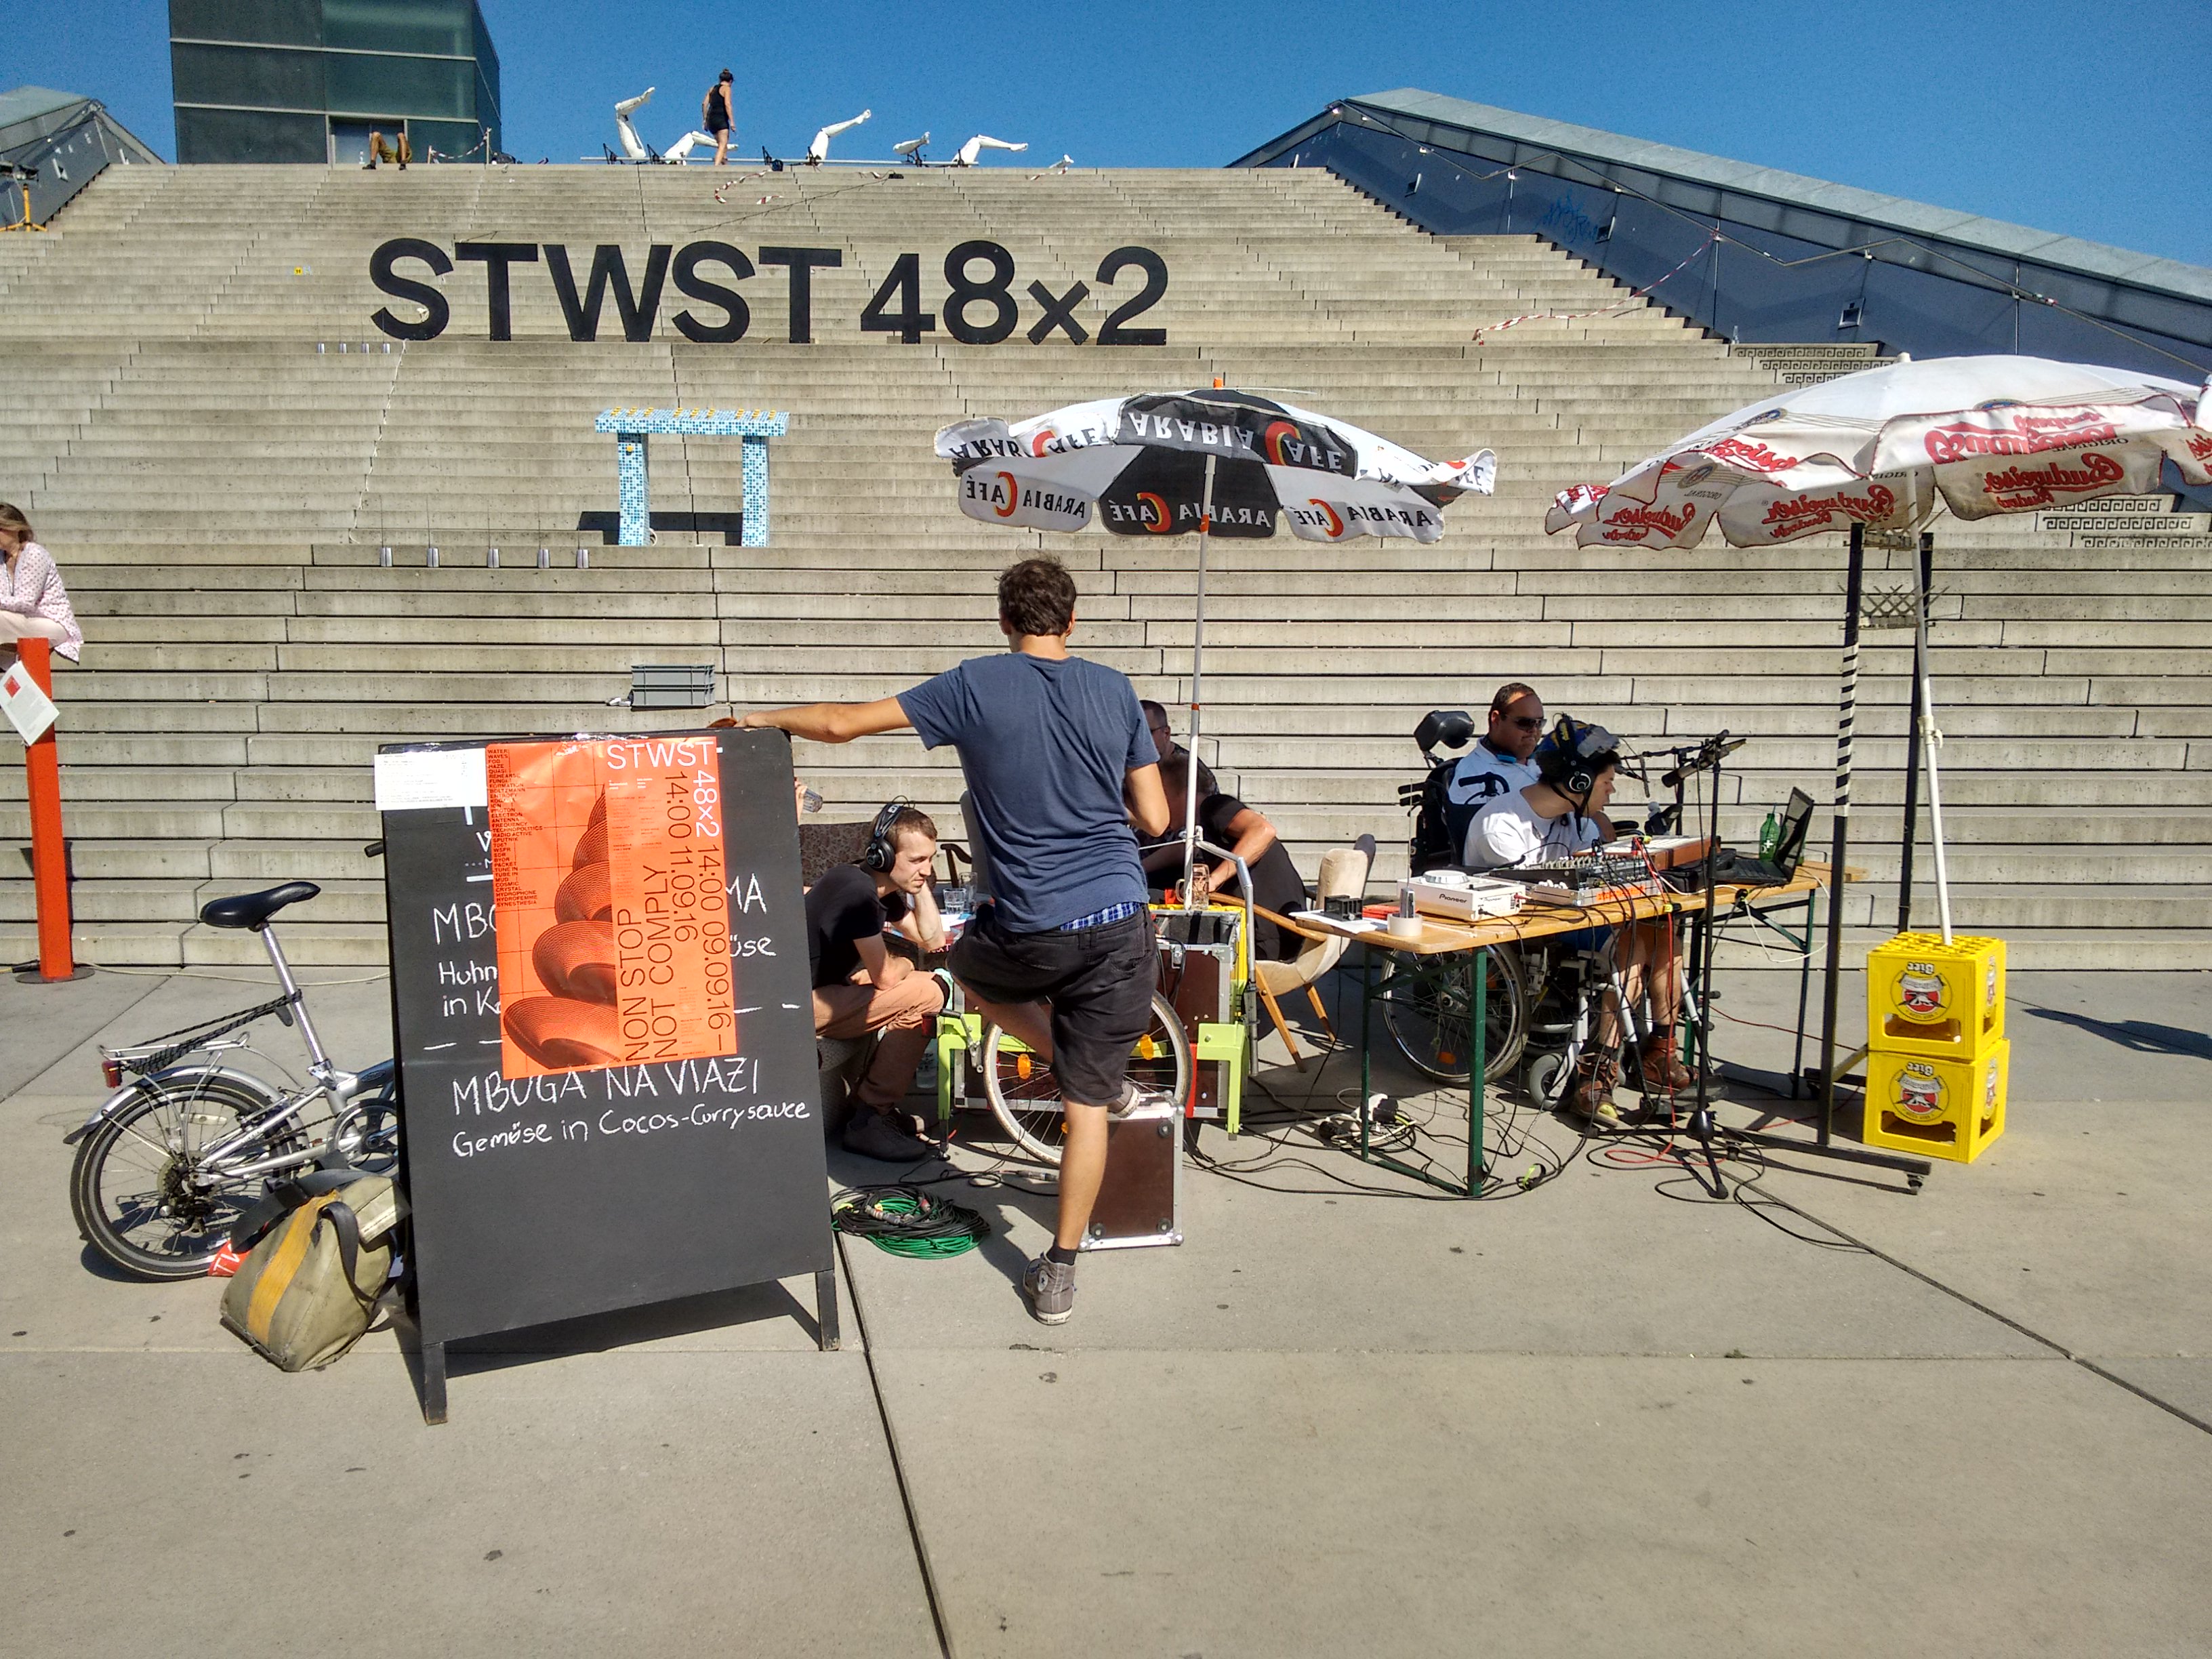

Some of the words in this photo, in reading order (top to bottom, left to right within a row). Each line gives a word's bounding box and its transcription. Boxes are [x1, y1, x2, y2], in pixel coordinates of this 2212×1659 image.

[370, 237, 842, 344] STWST
[607, 741, 714, 770] STWST
[665, 771, 692, 838] 14:00
[670, 846, 699, 942] 11.09.16
[698, 844, 724, 912] 14:00
[1439, 893, 1468, 904] Pioneer
[617, 908, 645, 987] STOP
[642, 865, 674, 985] COMPLY
[443, 995, 467, 1017] in
[702, 920, 731, 1030] 09.09.16
[623, 996, 650, 1061] NON
[651, 998, 678, 1059] NOT
[452, 1069, 588, 1116] MBUGA
[606, 1064, 658, 1101] NA
[666, 1057, 758, 1096] VIAZI
[453, 1121, 553, 1158] Gemüse
[562, 1119, 588, 1142] in
